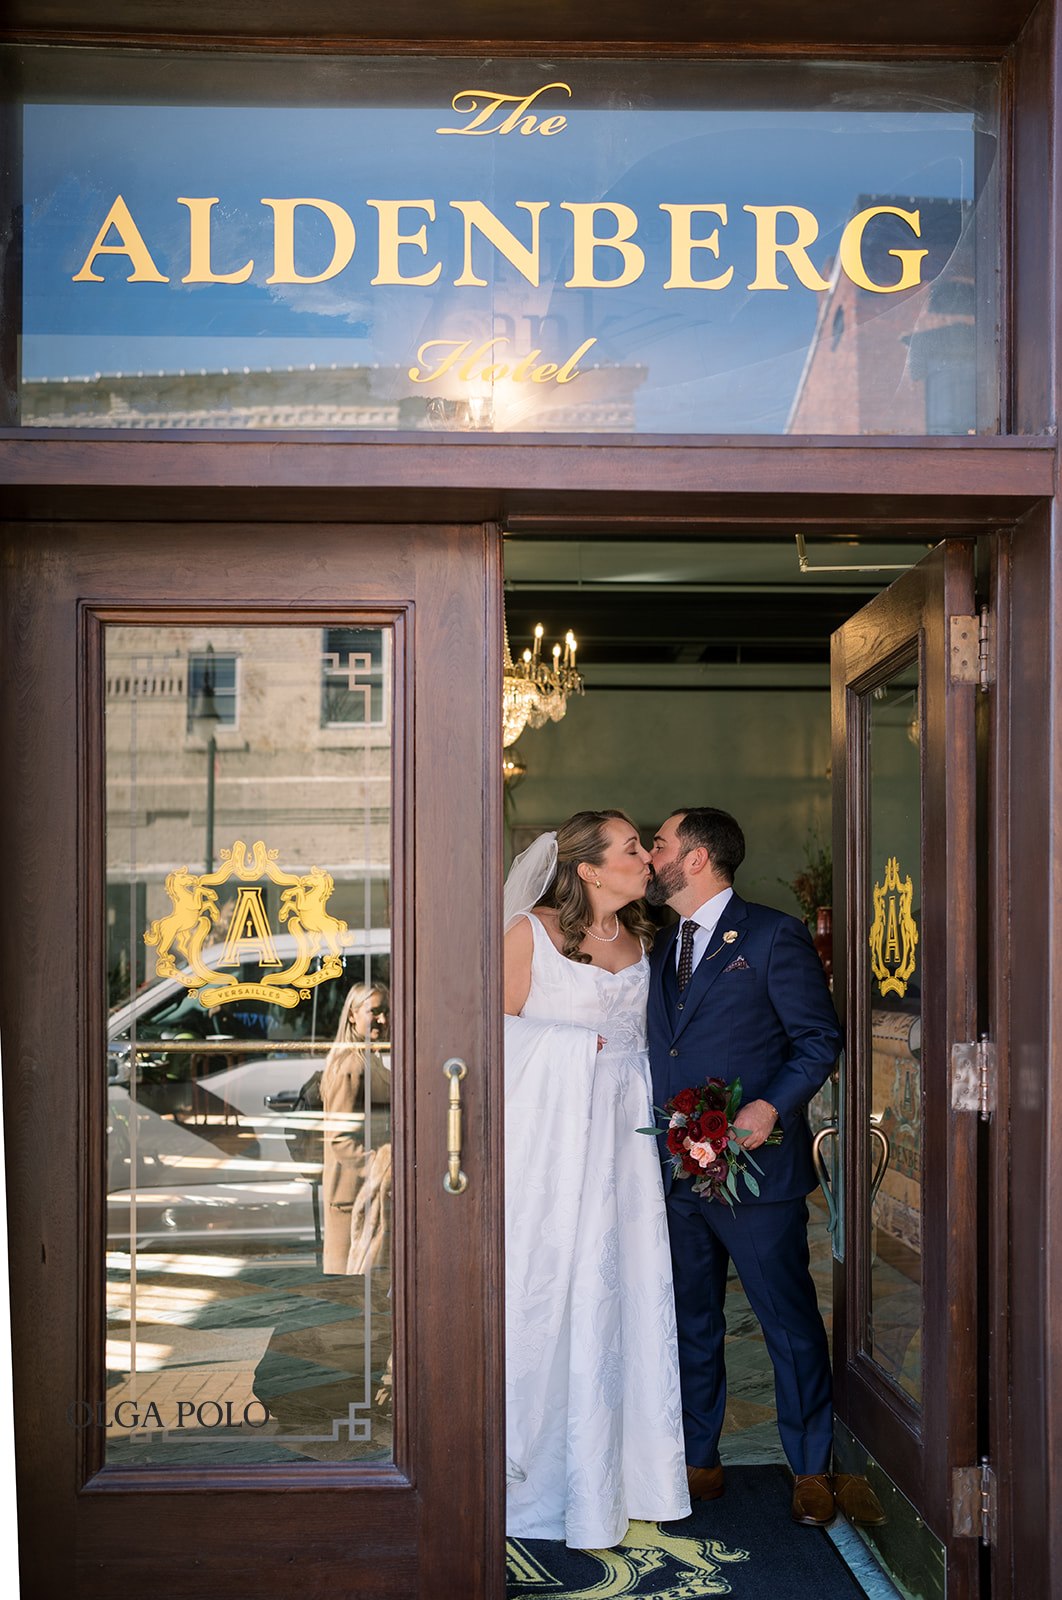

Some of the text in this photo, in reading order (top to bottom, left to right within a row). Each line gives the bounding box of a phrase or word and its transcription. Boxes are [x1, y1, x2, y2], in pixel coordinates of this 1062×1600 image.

[437, 82, 572, 136] The
[72, 194, 929, 293] ALDENBERG
[408, 338, 597, 385] Hotel
[217, 886, 283, 967] A
[217, 988, 280, 999] VERSAILLES
[306, 971, 329, 985] 2024
